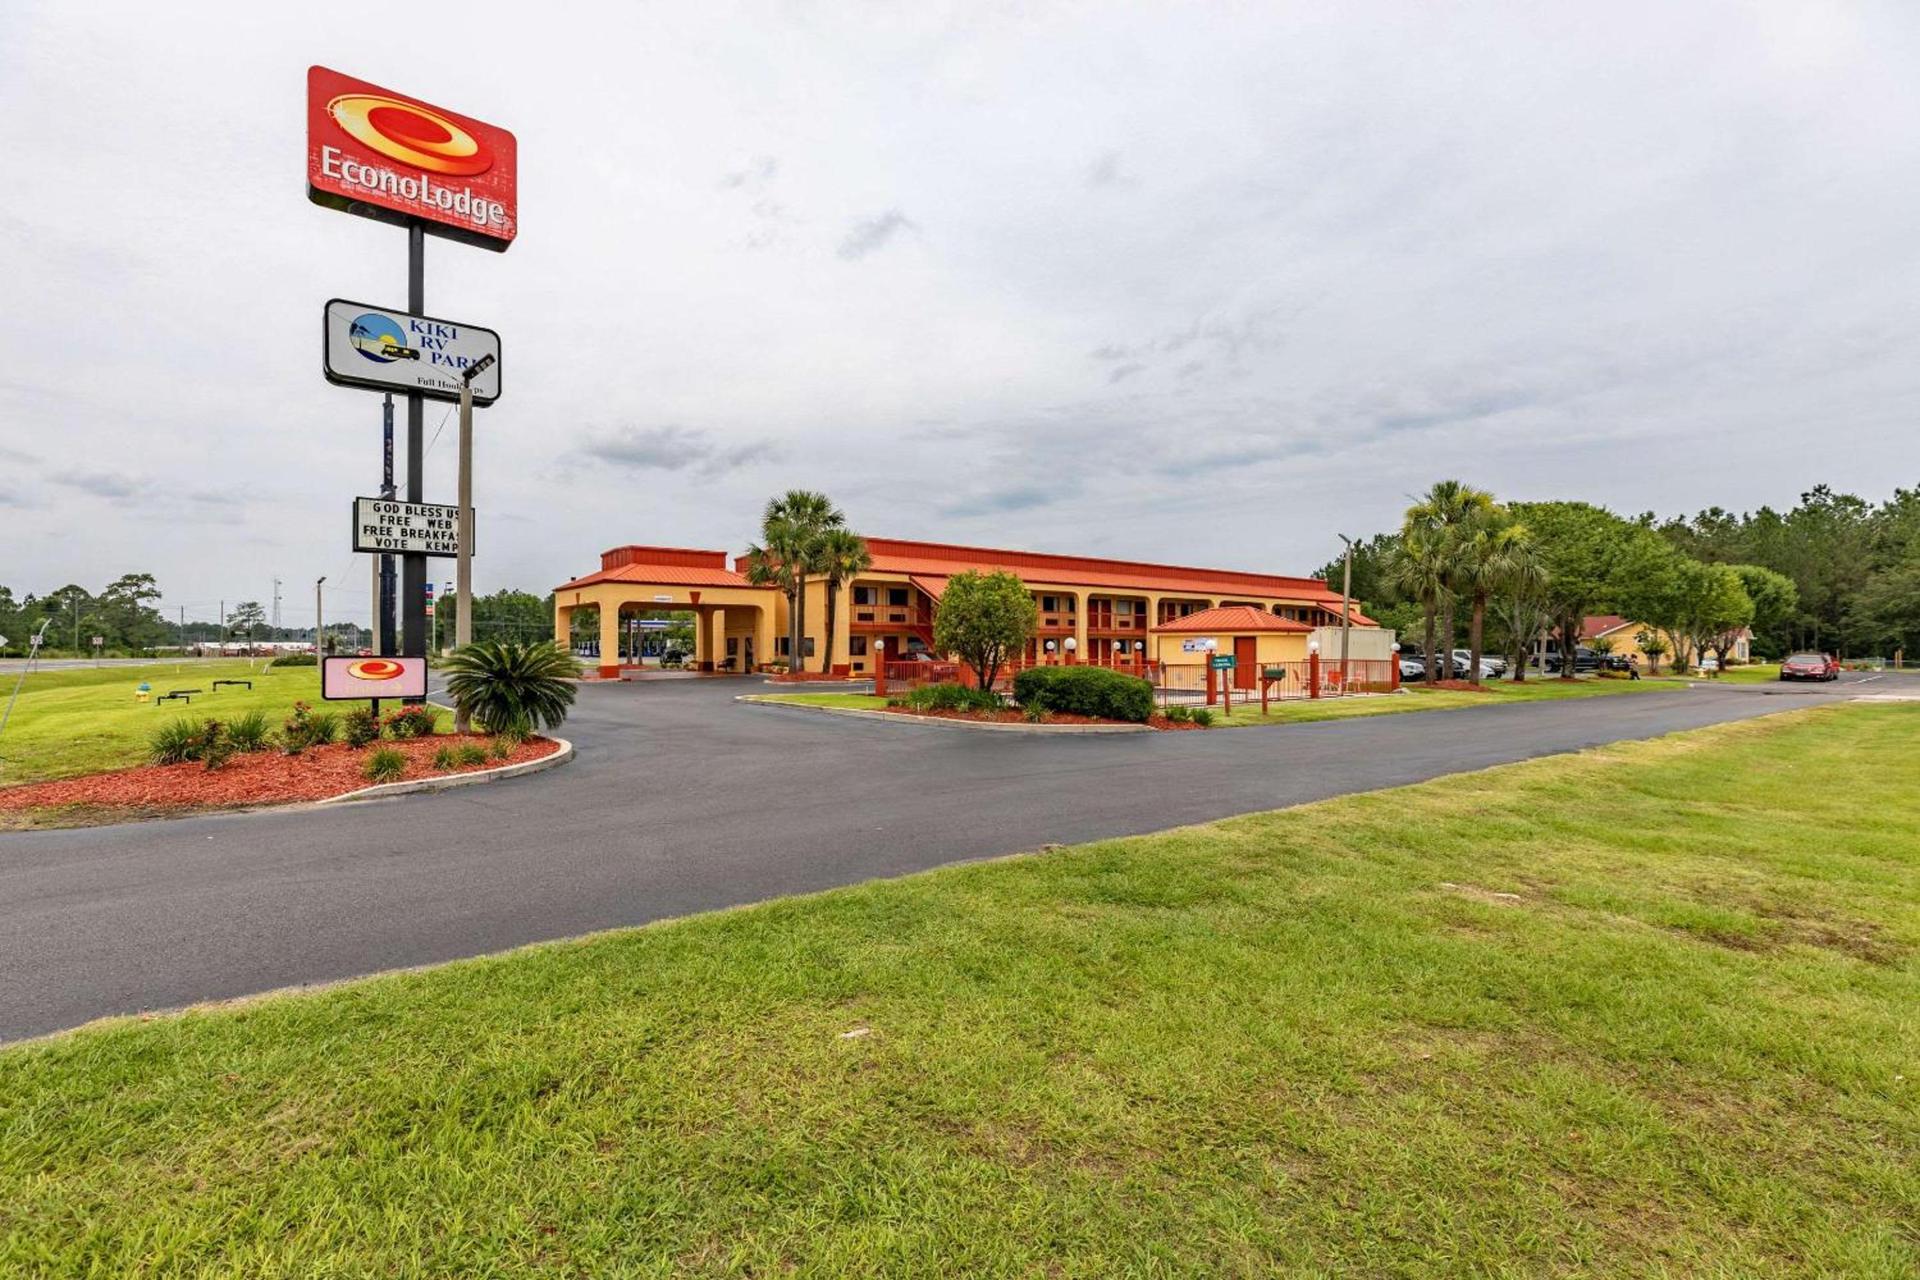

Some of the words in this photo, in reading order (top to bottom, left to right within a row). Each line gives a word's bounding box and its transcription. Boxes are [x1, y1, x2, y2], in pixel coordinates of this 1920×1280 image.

[322, 145, 505, 225] EconoLodge
[411, 320, 457, 339] KIKI
[421, 336, 448, 350] RV
[417, 377, 435, 387] Full
[373, 502, 400, 514] GOD
[405, 505, 442, 518] BLESS
[379, 515, 411, 527] FREE
[427, 519, 452, 530] WEB
[363, 525, 393, 537] FREE
[400, 528, 459, 541] BREAKFA
[375, 537, 408, 549] VOTE
[425, 541, 459, 552] KEMP
